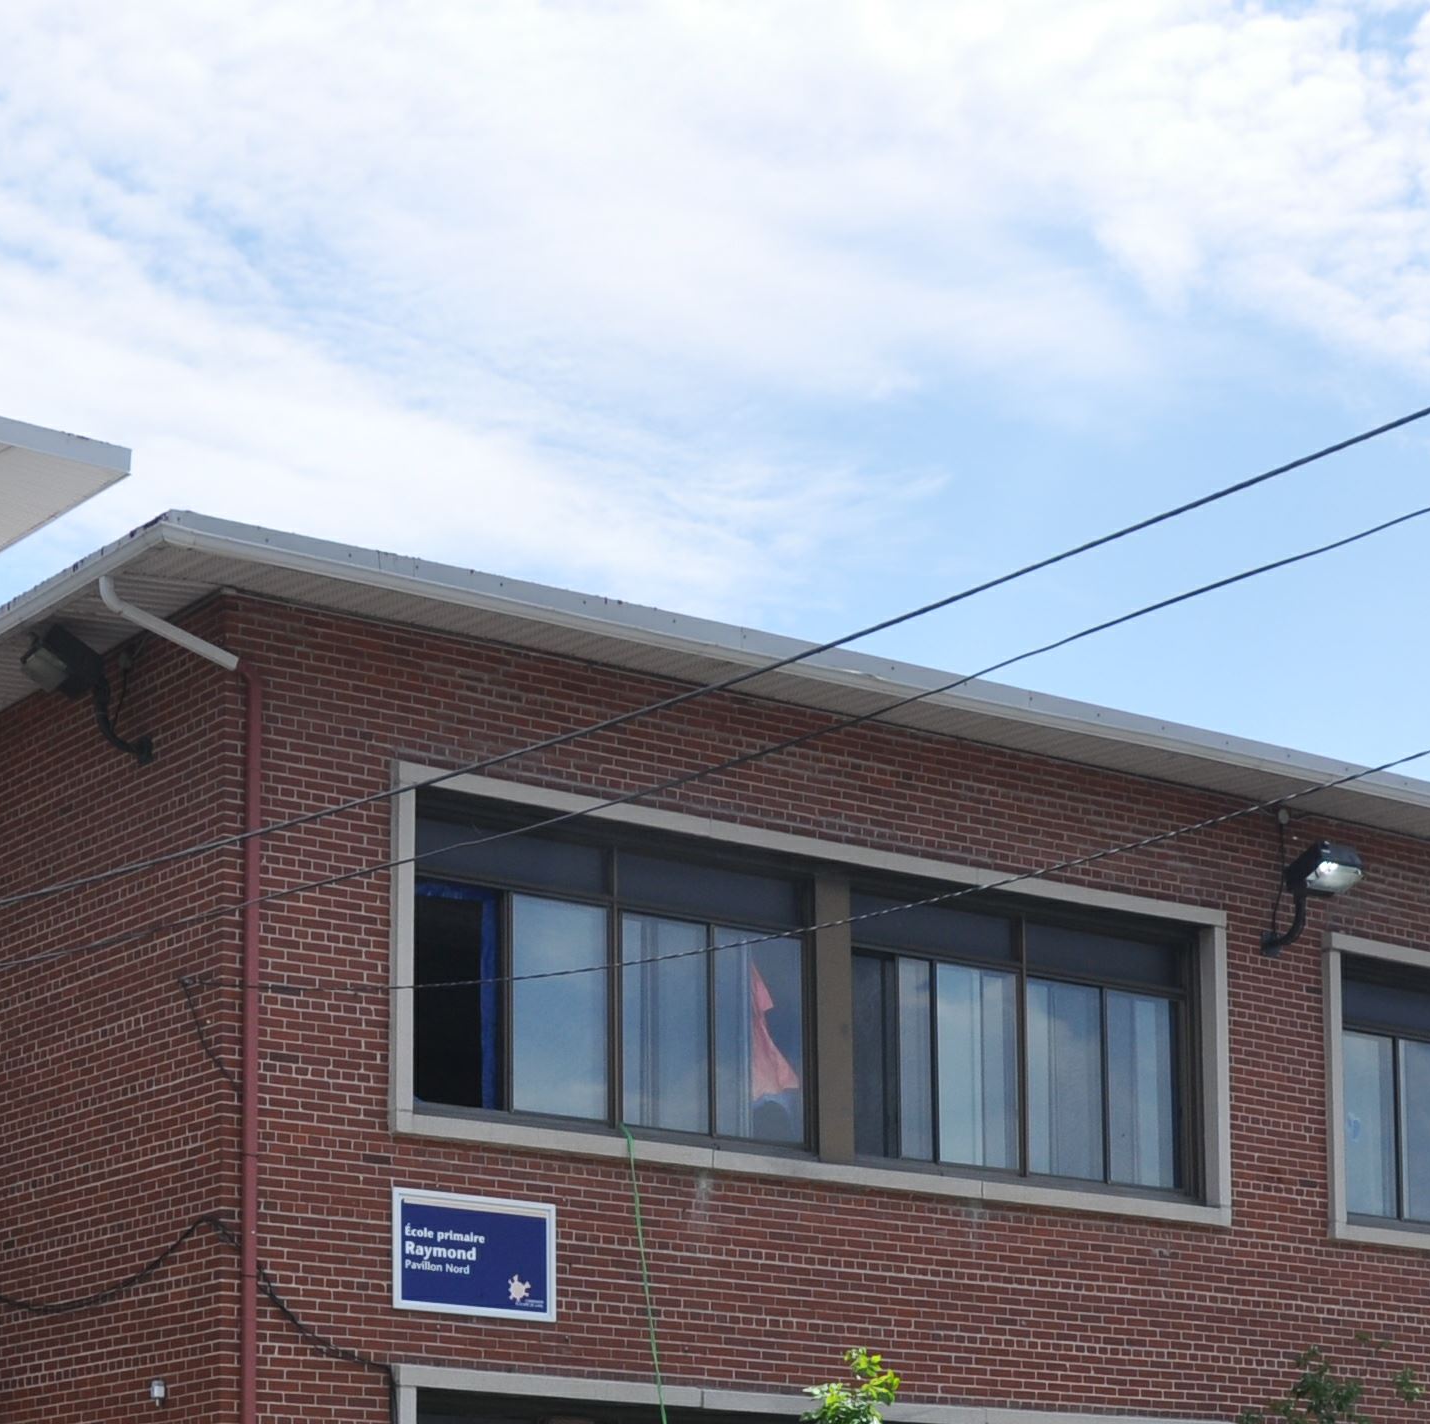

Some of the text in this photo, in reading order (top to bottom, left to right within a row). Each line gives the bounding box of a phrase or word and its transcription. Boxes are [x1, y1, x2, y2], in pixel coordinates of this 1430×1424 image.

[404, 1222, 485, 1244] École primaire
[404, 1240, 477, 1261] Raymond
[404, 1258, 470, 1275] Pavillon Nord
